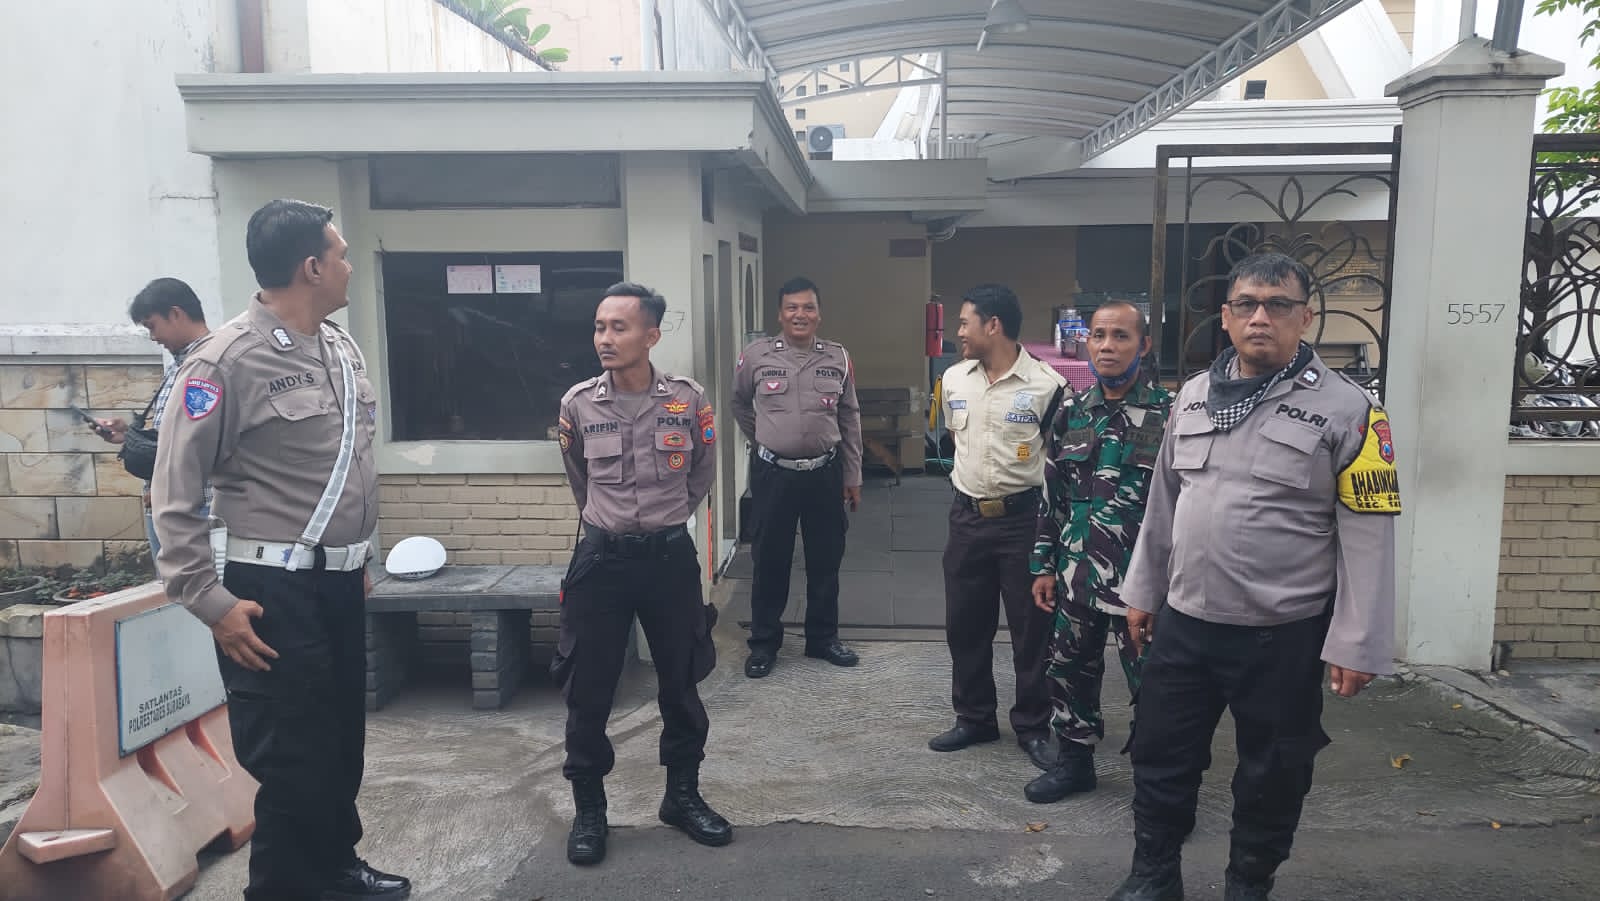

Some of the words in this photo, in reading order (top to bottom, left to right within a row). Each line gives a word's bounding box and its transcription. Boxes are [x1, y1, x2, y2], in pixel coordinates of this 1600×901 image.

[1447, 303, 1505, 325] 55-57
[656, 416, 692, 428] POLRI
[1275, 403, 1329, 429] POLRI
[138, 685, 183, 714] SATLANTAS
